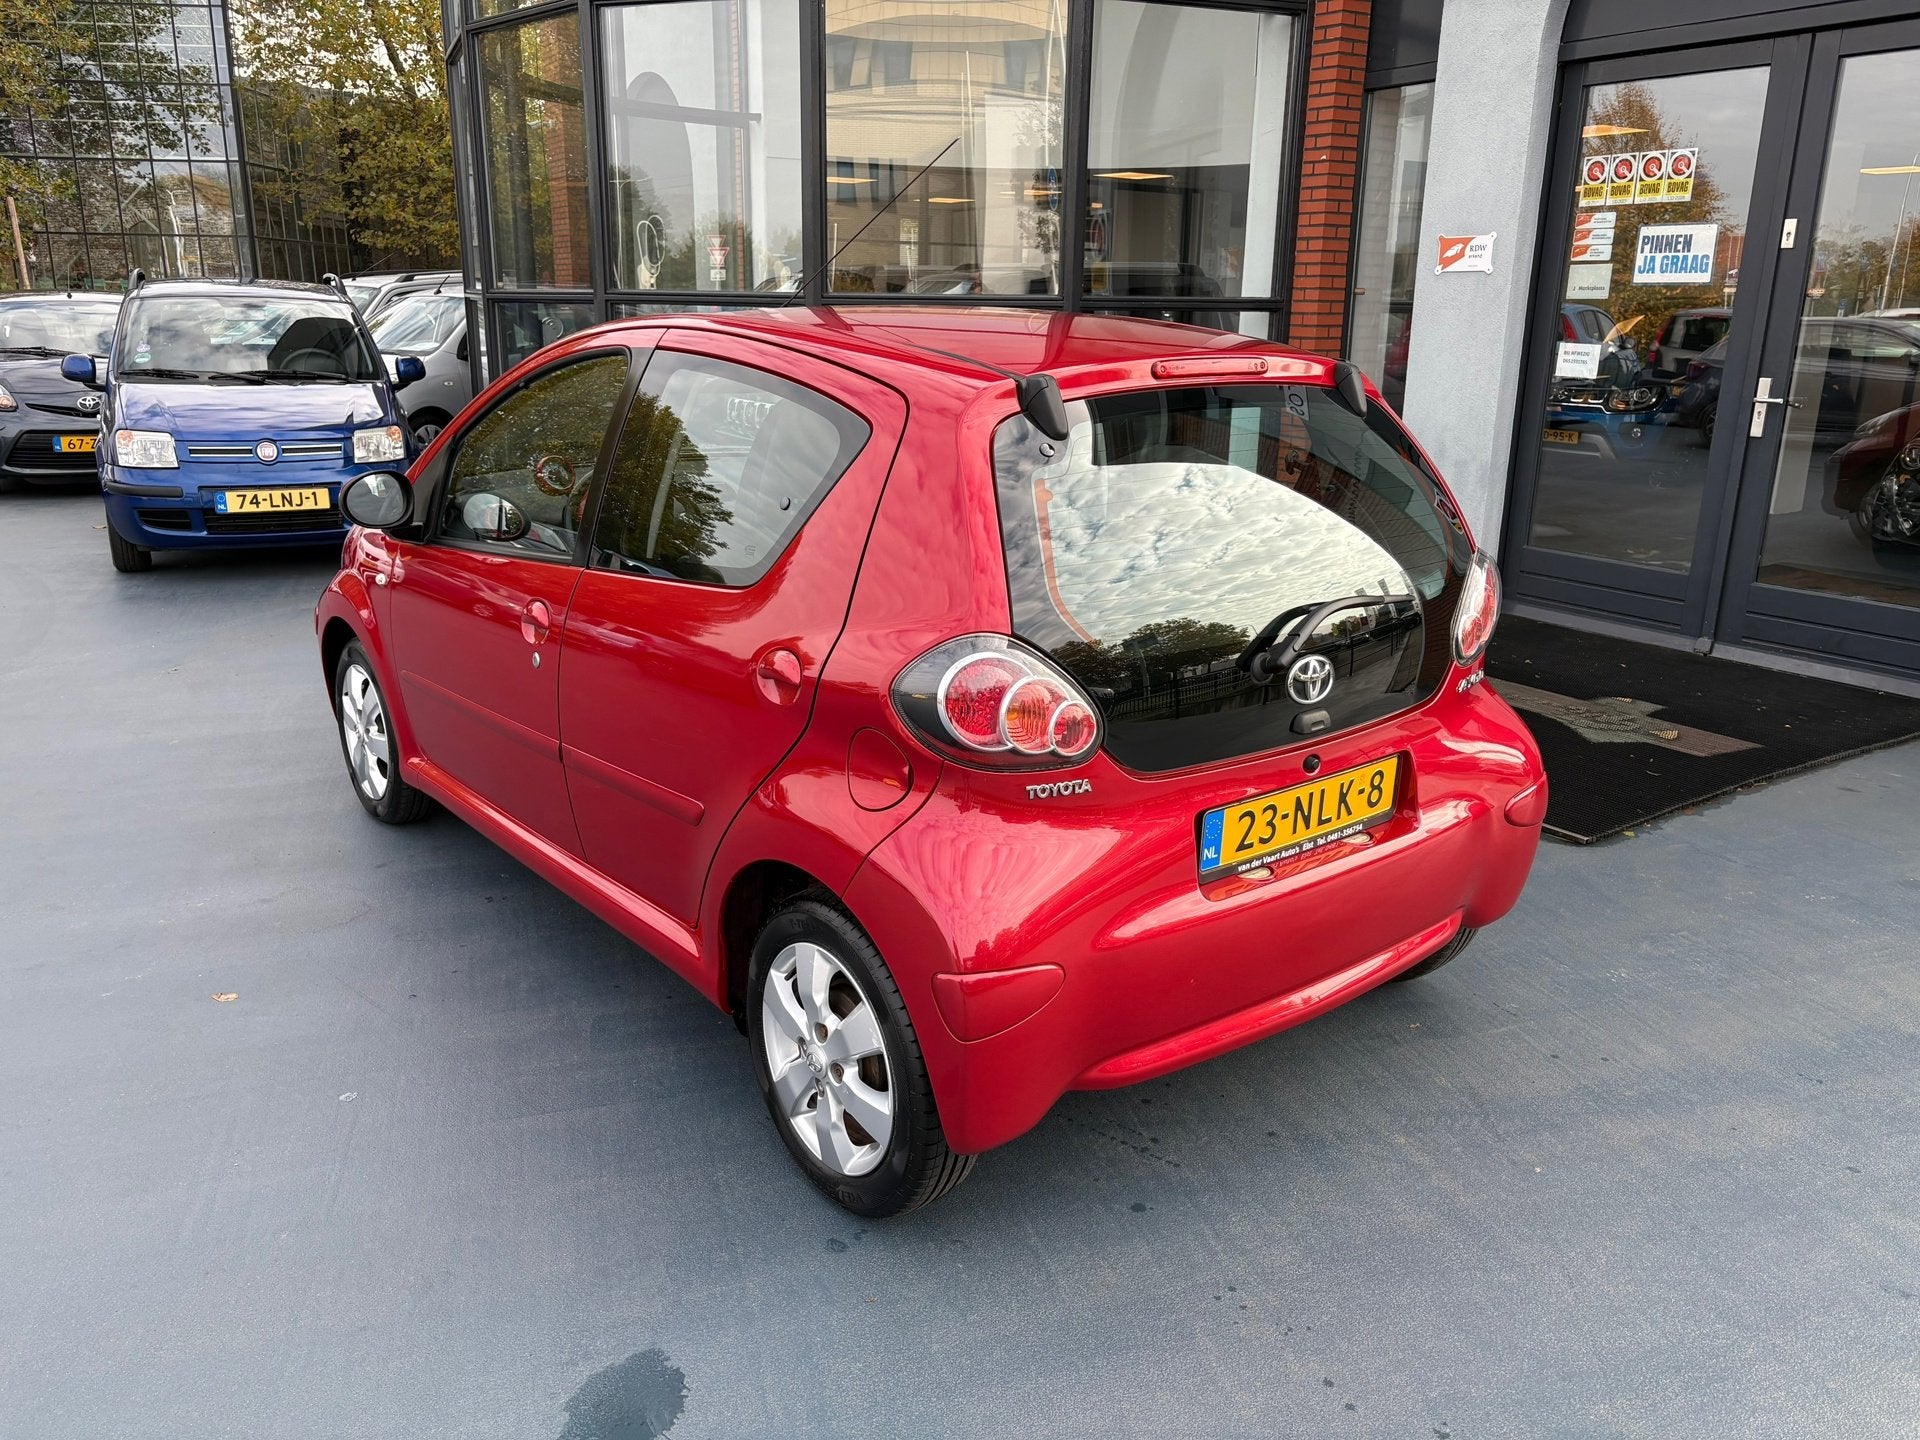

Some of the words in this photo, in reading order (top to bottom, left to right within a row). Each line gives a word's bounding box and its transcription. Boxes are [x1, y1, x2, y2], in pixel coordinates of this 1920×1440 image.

[1583, 187, 1604, 198] BOVAG
[1610, 184, 1631, 196] BOVAG
[1639, 182, 1661, 195] BOVAG
[1667, 181, 1689, 193] BOVAG
[1469, 244, 1487, 252] RDW
[1640, 234, 1693, 254] PINNEN
[1638, 255, 1656, 274] JA
[1660, 254, 1710, 274] GRAAG
[236, 491, 318, 510] 74-LNJ-1
[1025, 779, 1092, 800] TOYOTA
[1235, 769, 1385, 852] 23-NLK-8
[1203, 846, 1218, 861] NL
[1238, 864, 1250, 872] van
[1251, 859, 1262, 868] der
[1263, 853, 1280, 864] Vaart
[1281, 846, 1300, 858] Auto's
